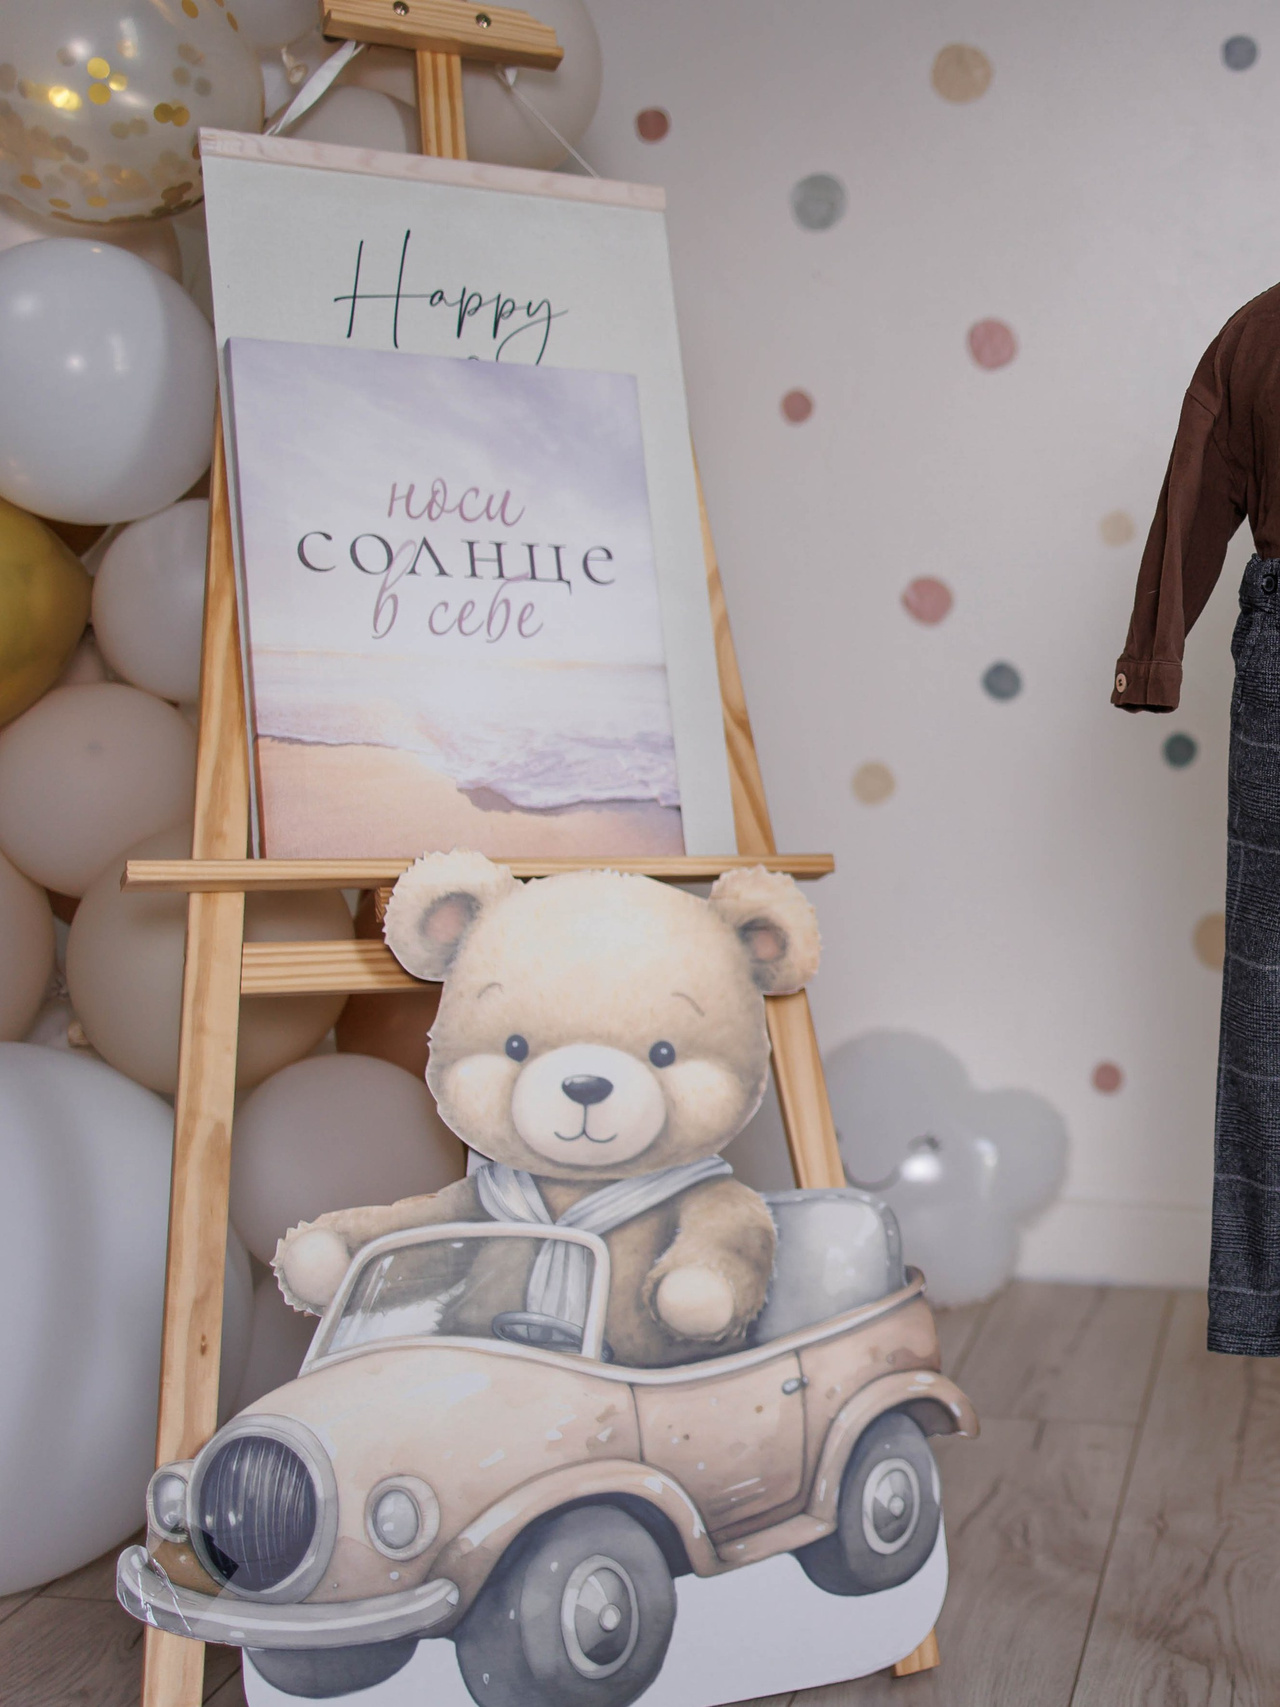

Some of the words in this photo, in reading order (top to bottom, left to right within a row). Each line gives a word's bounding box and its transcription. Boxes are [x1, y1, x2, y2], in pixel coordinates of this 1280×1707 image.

[334, 229, 569, 365] Happy
[388, 477, 526, 527] носи
[428, 572, 544, 643] себе
